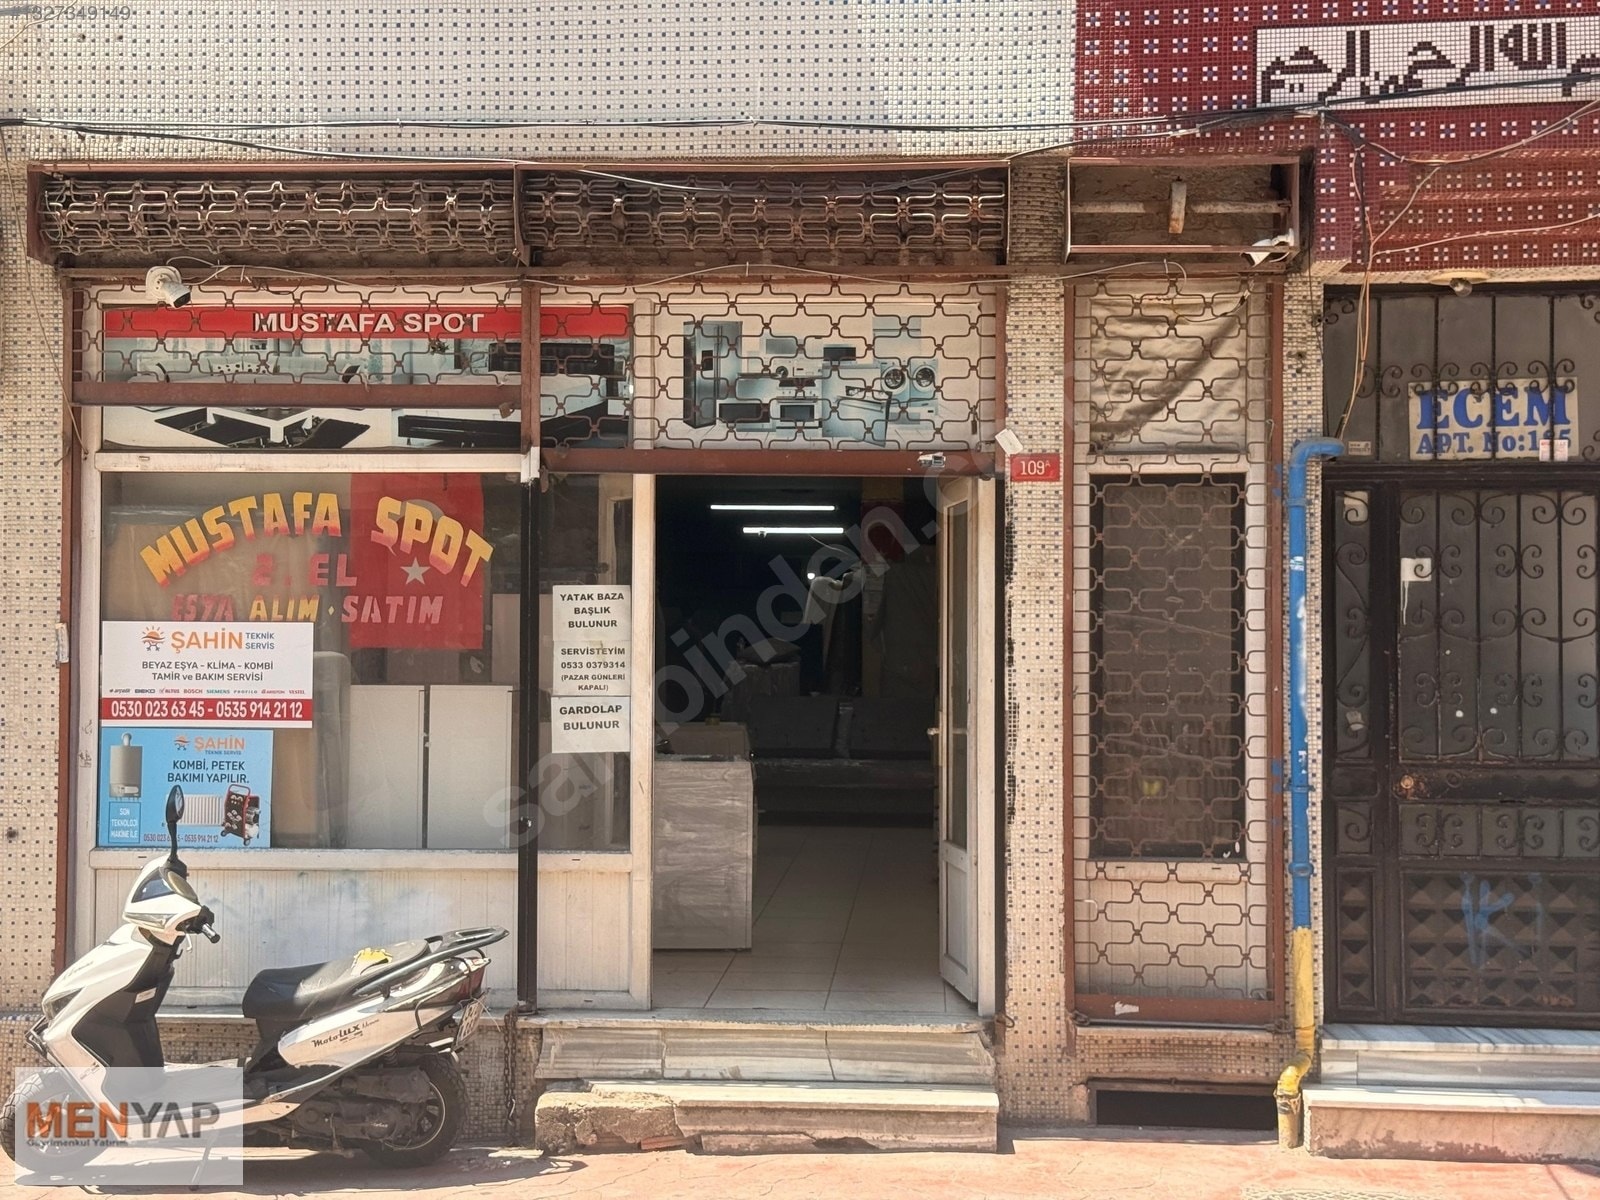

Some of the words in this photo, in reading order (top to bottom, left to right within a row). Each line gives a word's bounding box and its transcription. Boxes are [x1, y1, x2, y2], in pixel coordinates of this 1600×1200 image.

[253, 313, 395, 333] MUSTAFA
[403, 313, 485, 333] SPOT
[1416, 386, 1571, 429] ECEM
[1416, 432, 1474, 454] APT.
[1483, 428, 1572, 453] No:15
[139, 491, 342, 588] MUSTAFA
[370, 495, 494, 588] SPOT
[308, 553, 357, 588] EL
[560, 593, 594, 602] YATAK
[597, 592, 624, 601] BAZA
[248, 594, 321, 622] ALIM
[341, 595, 443, 623] SATIM
[574, 606, 611, 616] BAŞLIK
[568, 619, 617, 628] BULUNUR
[171, 627, 243, 653] ŞAHİN
[245, 631, 275, 640] TEKNİK
[245, 642, 275, 650] SERVİS
[561, 646, 625, 656] SERVİSTEYİM
[142, 661, 172, 670] BEYAZ
[174, 661, 198, 672] EŞYA
[207, 660, 236, 670] KLİMA
[244, 660, 273, 671] KOMBİ
[561, 661, 584, 669] 0533
[586, 660, 625, 669] 0379314
[152, 671, 181, 681] TAMİR
[195, 672, 225, 681] BAKIM
[226, 671, 263, 682] SERVİSİ
[591, 672, 625, 681] GÜNLERİ
[111, 700, 142, 717] 0530
[145, 700, 167, 717] 023
[172, 701, 187, 718] 63
[189, 701, 205, 718] 45
[216, 701, 247, 718] 0535
[250, 701, 271, 718] 914
[273, 702, 287, 718] 21
[289, 702, 303, 718] 12
[559, 704, 623, 716] GARDOLAP
[563, 720, 620, 731] BULUNUR
[194, 735, 245, 752] ŞAHİN
[173, 758, 208, 771] KOMBİ,
[211, 760, 245, 771] PETEK
[167, 773, 204, 783] BAKIMI
[206, 773, 249, 783] YAPILIR.
